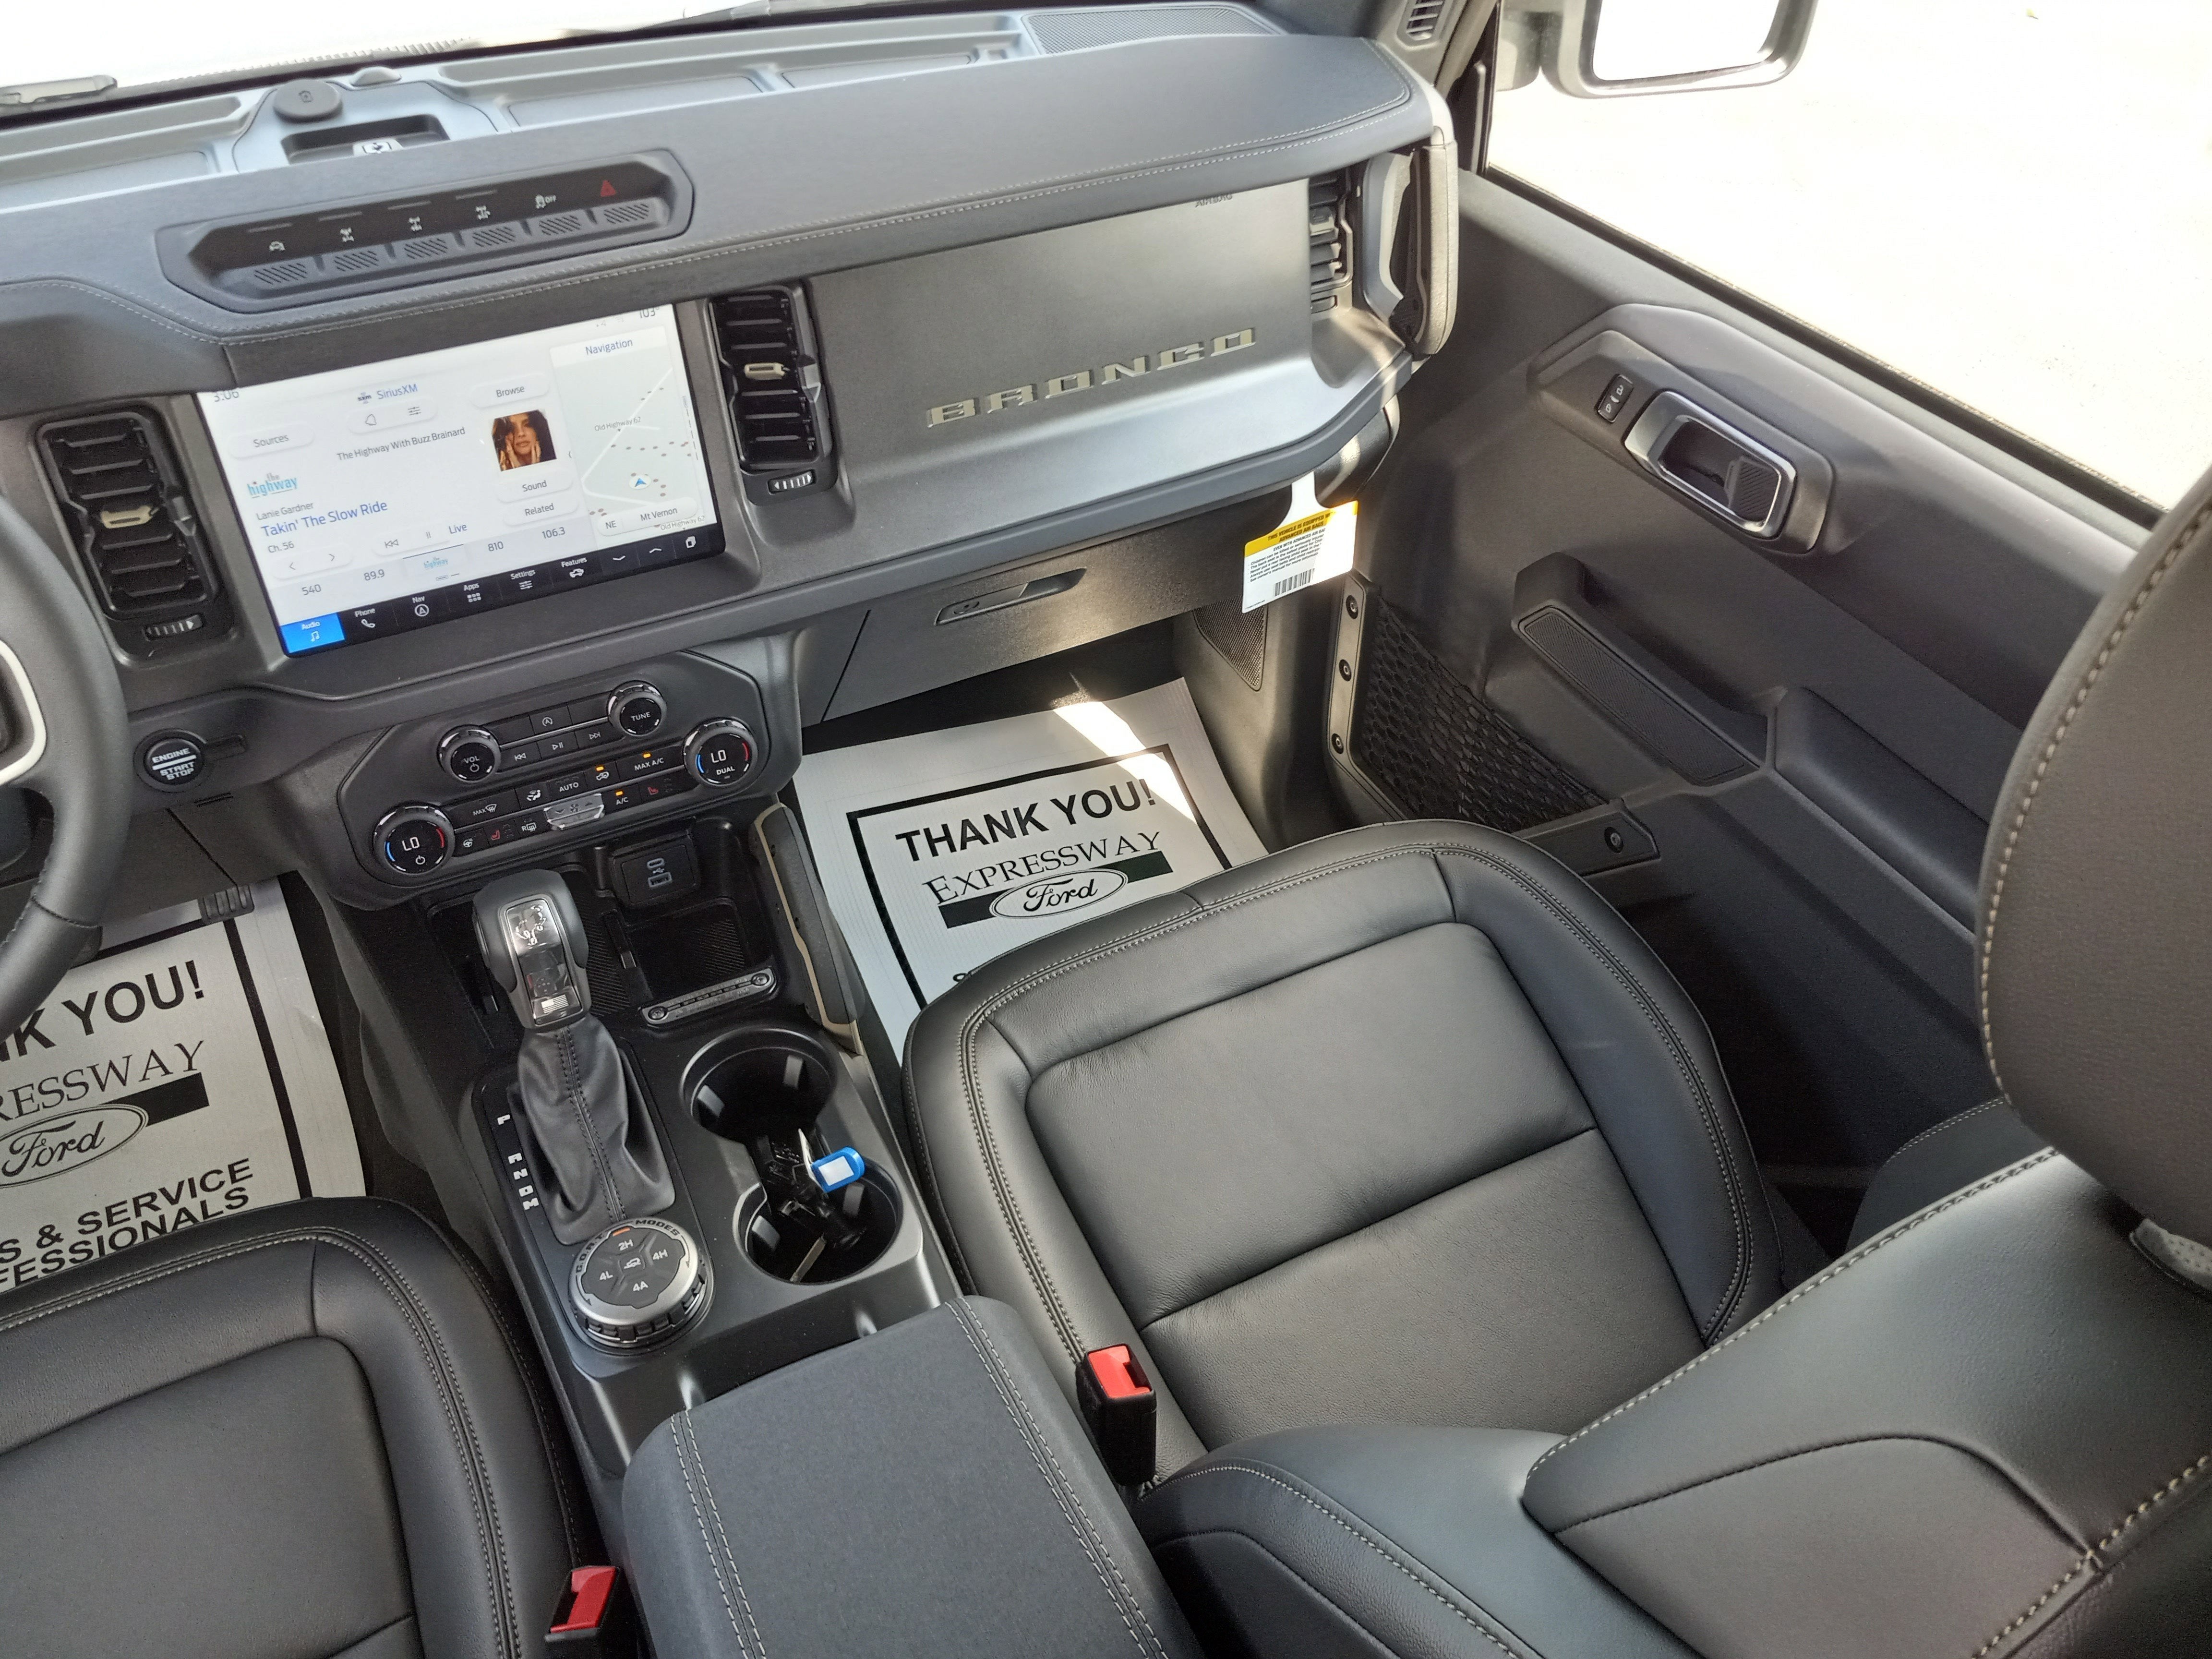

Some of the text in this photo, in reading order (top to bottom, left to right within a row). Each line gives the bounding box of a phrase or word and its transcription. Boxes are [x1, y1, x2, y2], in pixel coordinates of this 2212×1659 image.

[544, 195, 557, 203] OFF
[585, 339, 633, 355] Navigation
[926, 327, 1256, 428] BRONCO
[376, 384, 418, 400] SiriusXM
[496, 386, 525, 397] Browse
[606, 419, 632, 429] Highway
[252, 434, 289, 448] Sources
[337, 426, 466, 461] The Highway With Buzz Brainard
[266, 472, 280, 481] the
[246, 478, 298, 496] highway
[521, 480, 547, 492] Sound
[256, 503, 314, 521] Lanie Gardner
[524, 503, 554, 517] Related
[640, 507, 678, 522] Mt Vernon
[261, 501, 388, 537] Takin' The Slow Ride
[605, 520, 617, 529] NE
[672, 519, 697, 529] Highway
[448, 524, 468, 535] Live
[541, 527, 566, 539] 106.3
[1278, 529, 1303, 542] ADVANCED
[1279, 526, 1297, 536] VEHICLE
[268, 541, 295, 553] Ch. 56
[487, 541, 504, 552] 810
[561, 557, 588, 568] Features
[363, 568, 385, 581] 89.9
[510, 569, 536, 580] Settings
[301, 584, 322, 596] 540
[463, 582, 480, 591] Apps
[412, 595, 425, 603] Nav
[354, 607, 376, 617] Phone
[301, 620, 321, 630] Audio
[630, 711, 651, 722] TUNE
[152, 747, 191, 764] ENGINE
[463, 755, 480, 764] VOL
[710, 749, 727, 763] LO
[159, 761, 195, 777] START
[634, 757, 665, 771] MAX A/C
[166, 767, 194, 781] STOP
[716, 766, 735, 775] DUAL
[559, 781, 579, 793] AUTO
[616, 796, 629, 805] A/C
[472, 808, 486, 816] MAX
[895, 778, 1157, 862] THANK YOU!
[402, 836, 420, 851] LO
[922, 831, 1162, 905] EXPRESSWAY
[1022, 878, 1099, 914] Ford
[0, 959, 205, 1062] K YOU!
[497, 1114, 511, 1125] P
[1, 1120, 106, 1178] Ford
[513, 1168, 529, 1180] N
[36, 1224, 64, 1249] &
[77, 1157, 254, 1235] SERVICE
[523, 1197, 540, 1210] M
[635, 1219, 680, 1236] MODES
[618, 1239, 634, 1251] 2H
[652, 1249, 669, 1261] 4H
[599, 1271, 613, 1281] 4L
[632, 1281, 649, 1292] 4A
